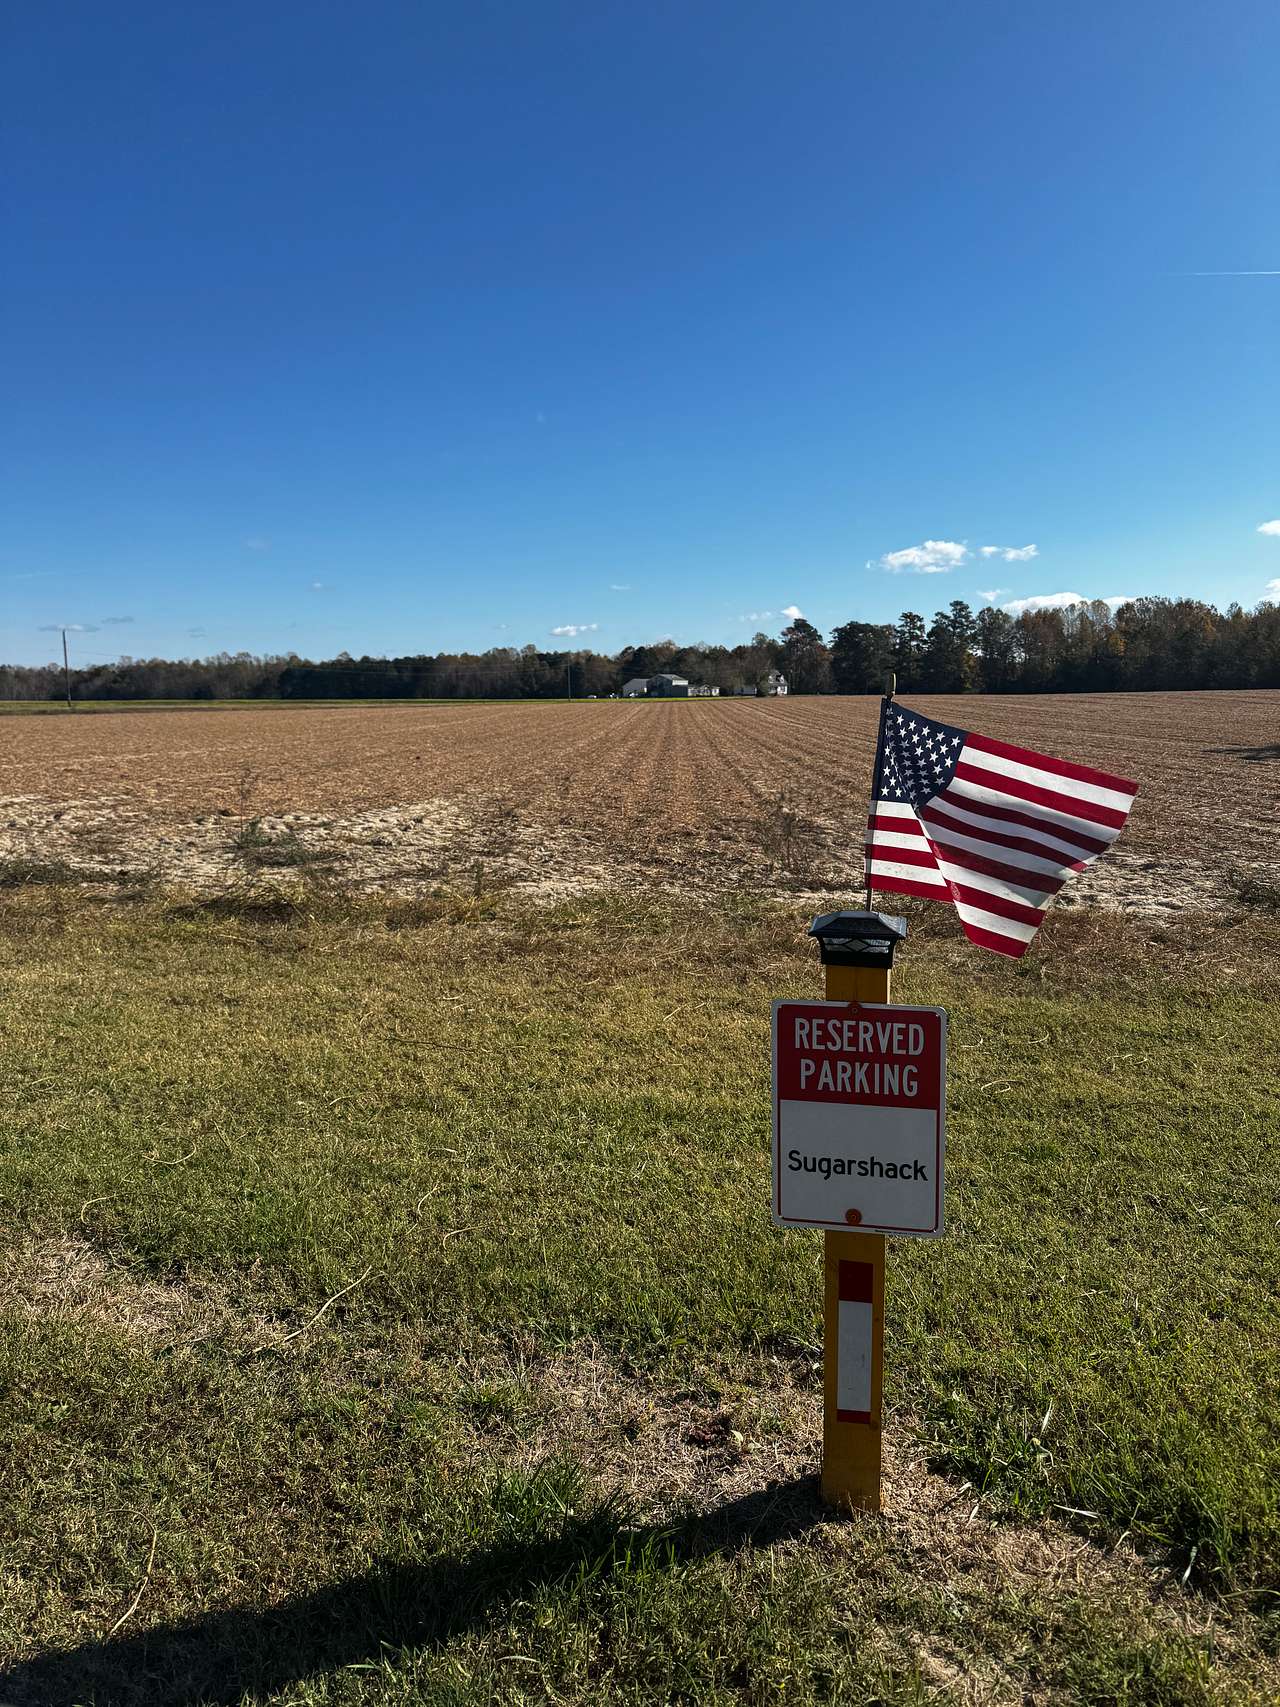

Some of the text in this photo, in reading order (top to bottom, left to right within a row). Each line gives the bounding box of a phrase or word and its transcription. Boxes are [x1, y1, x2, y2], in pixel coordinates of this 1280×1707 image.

[794, 1017, 925, 1056] RESERVED
[800, 1059, 918, 1097] PARKING
[787, 1149, 929, 1181] Sugarshack
